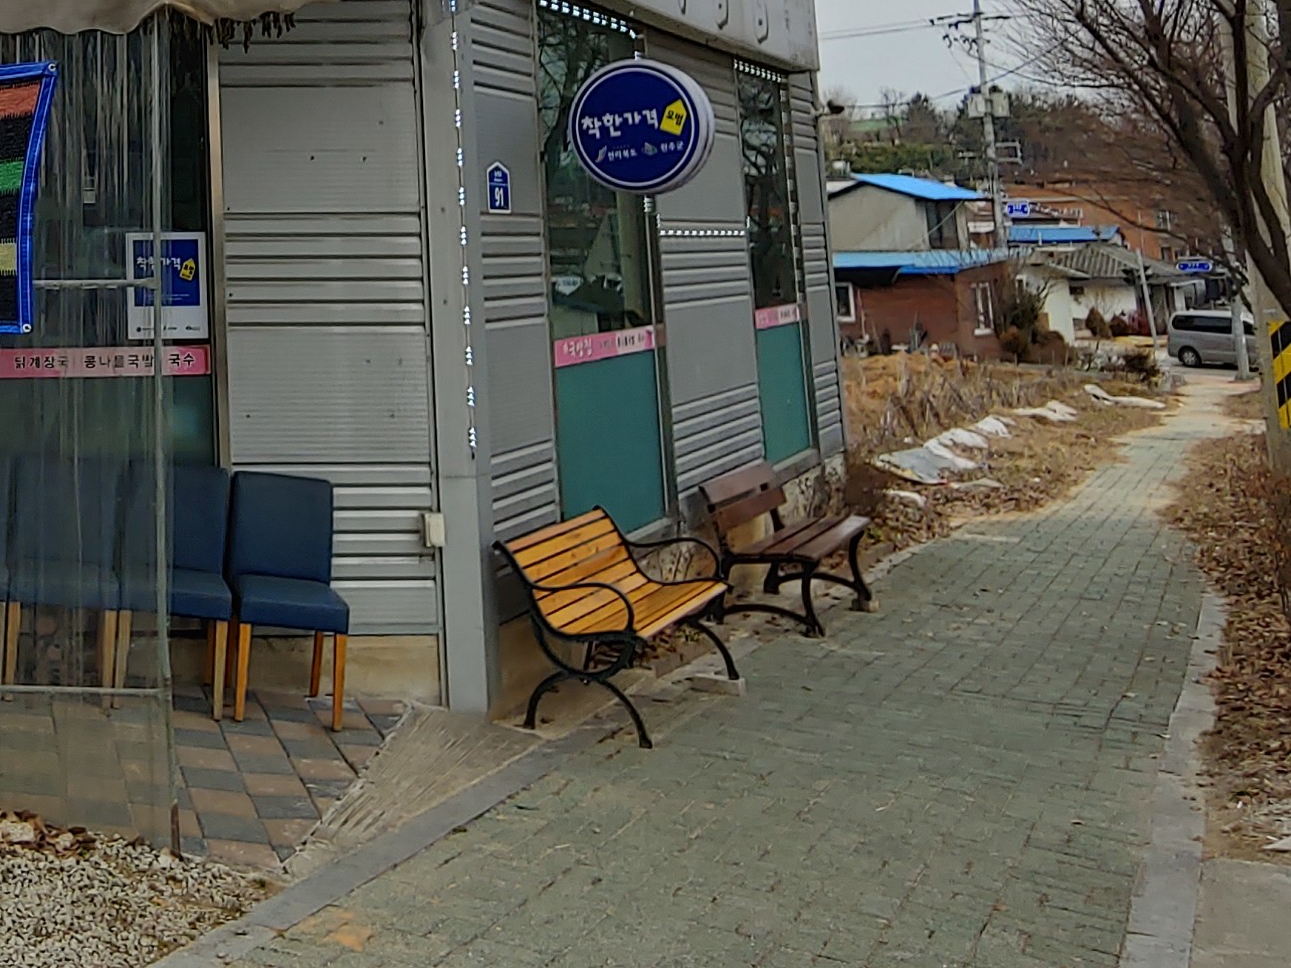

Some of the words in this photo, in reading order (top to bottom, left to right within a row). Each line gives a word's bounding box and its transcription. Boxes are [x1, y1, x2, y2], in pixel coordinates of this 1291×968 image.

[581, 108, 658, 139] 착한가격
[494, 187, 504, 207] 91
[168, 354, 195, 367] 국수
